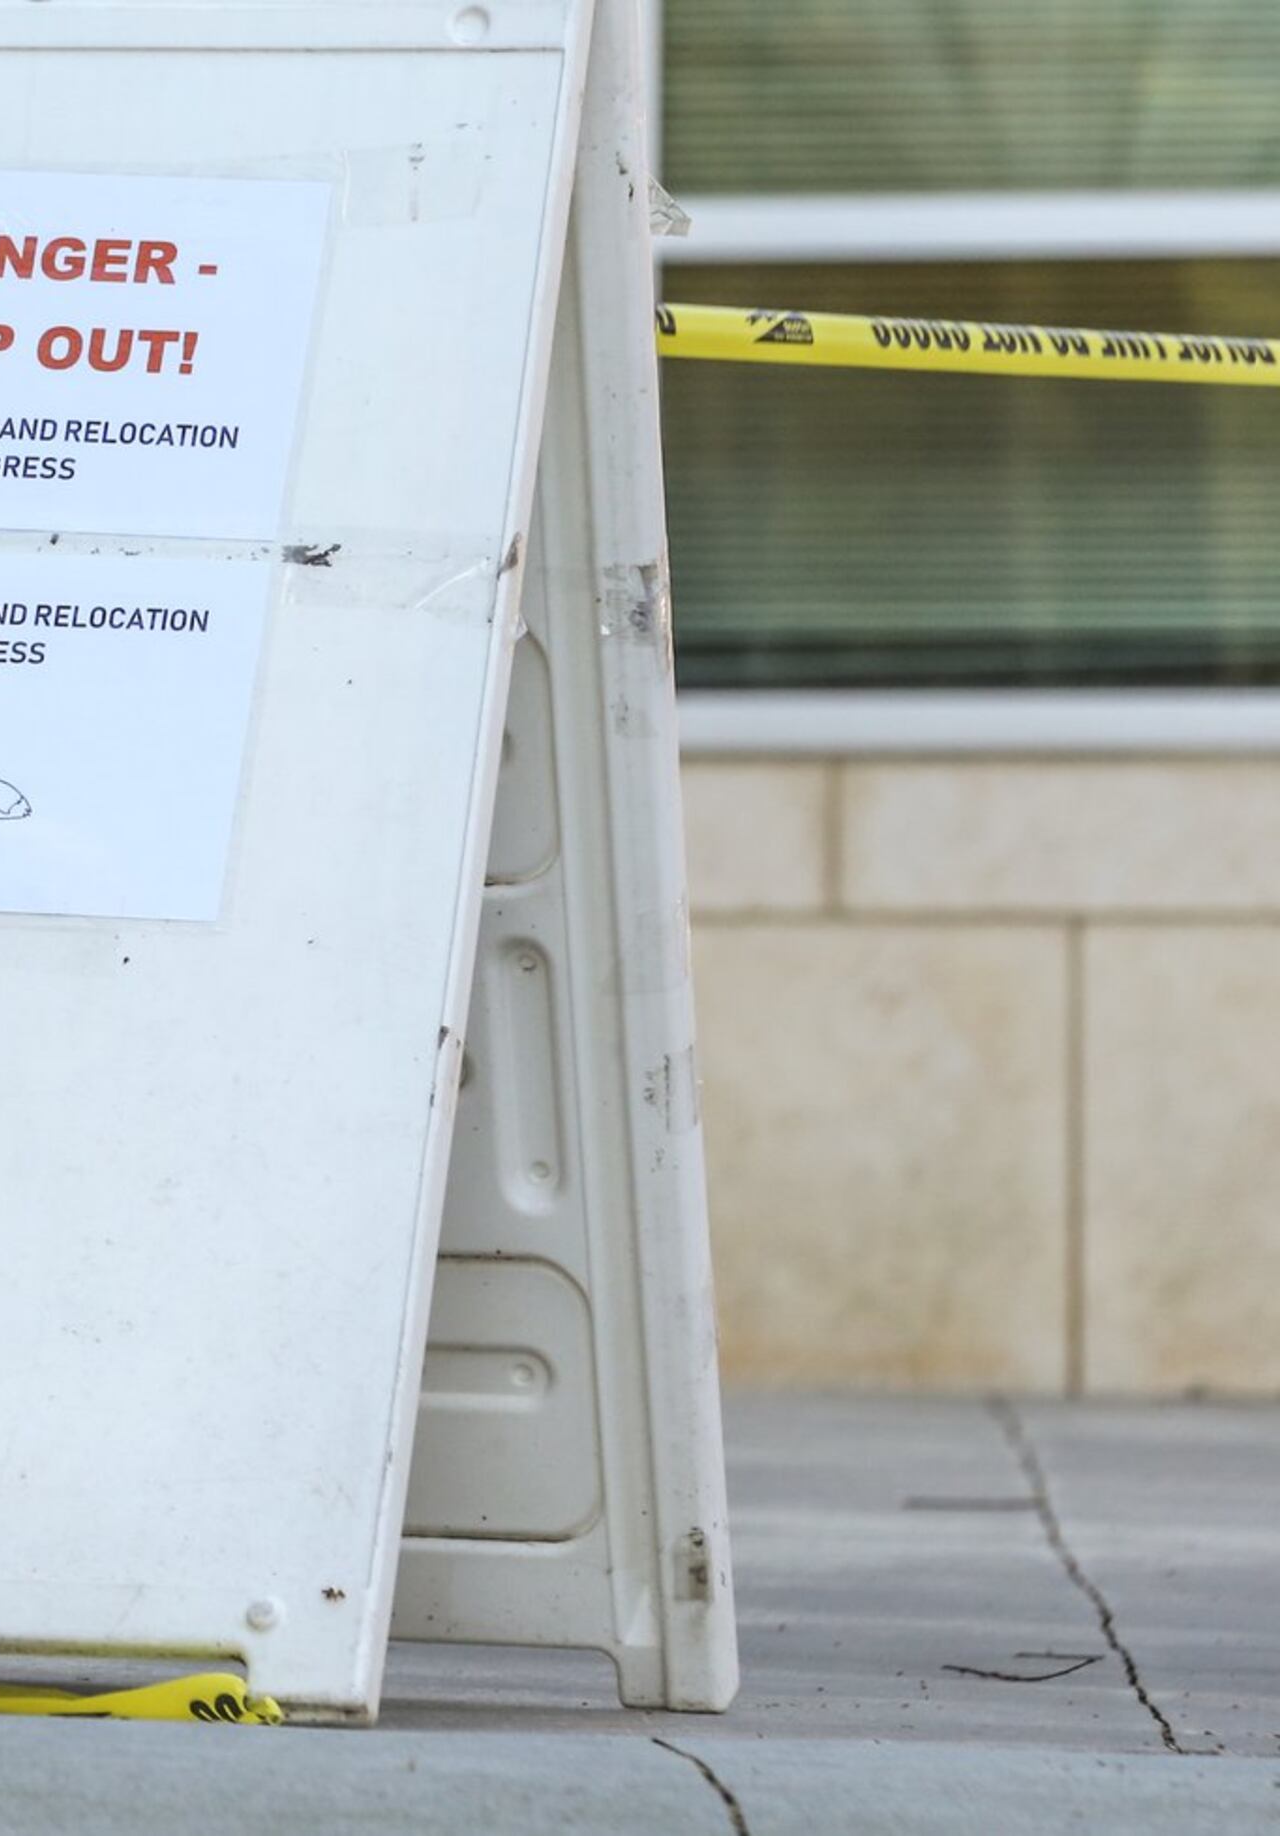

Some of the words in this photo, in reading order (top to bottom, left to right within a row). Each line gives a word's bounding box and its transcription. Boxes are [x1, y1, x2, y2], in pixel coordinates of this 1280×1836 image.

[36, 325, 200, 376] OUT!
[64, 420, 239, 449] RELOCATION
[33, 605, 210, 632] RELOCATION
